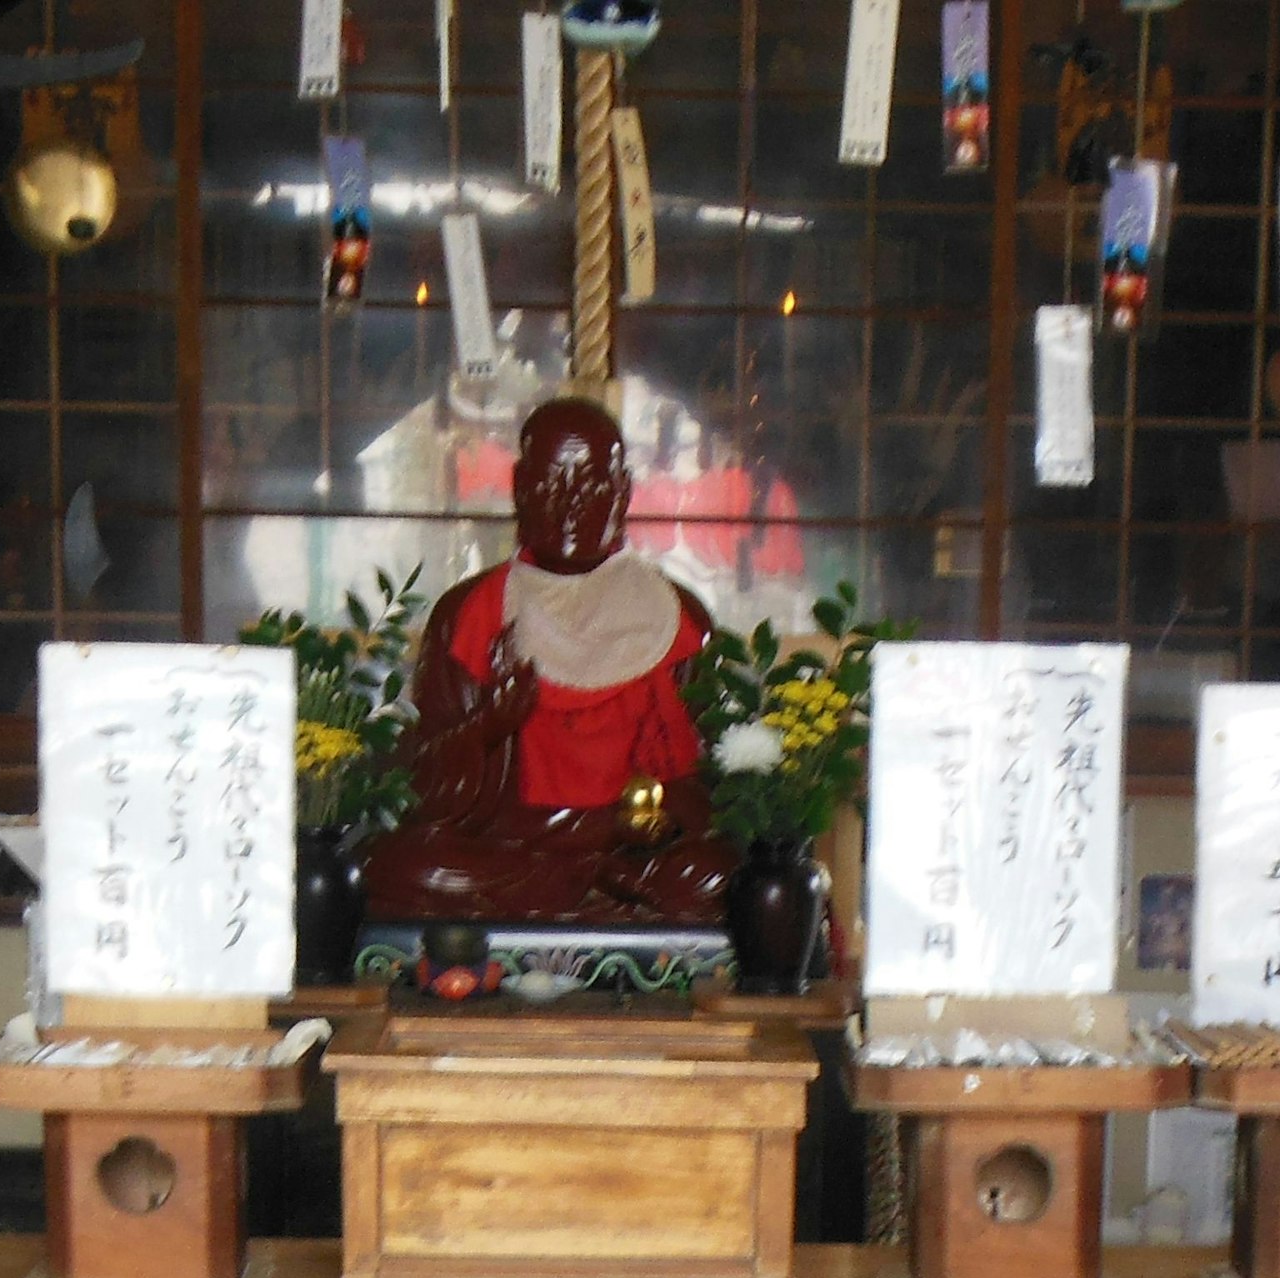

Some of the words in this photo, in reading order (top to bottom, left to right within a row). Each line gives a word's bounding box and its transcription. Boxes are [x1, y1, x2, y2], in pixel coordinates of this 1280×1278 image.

[92, 720, 136, 962] 一セット百円
[163, 686, 203, 865] おせんこう
[920, 726, 973, 962] 一セット百円
[998, 686, 1043, 866] おせんこう
